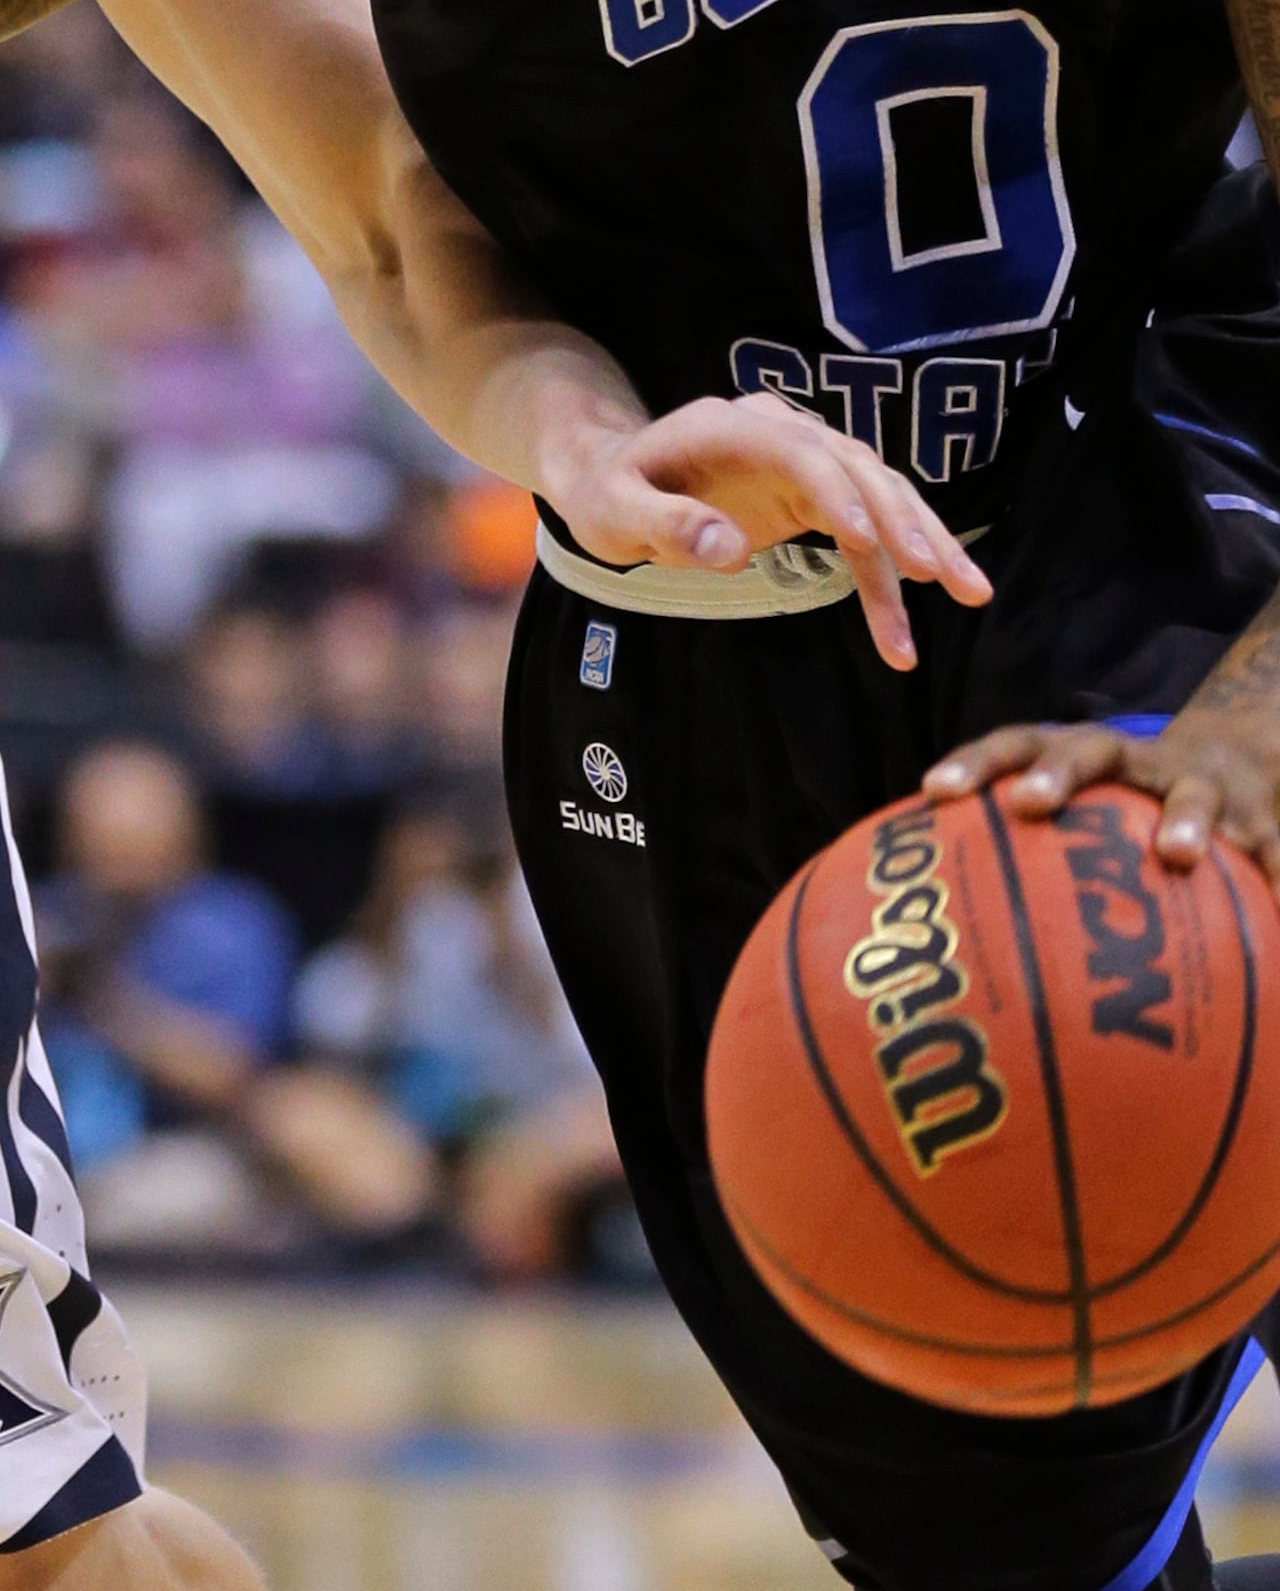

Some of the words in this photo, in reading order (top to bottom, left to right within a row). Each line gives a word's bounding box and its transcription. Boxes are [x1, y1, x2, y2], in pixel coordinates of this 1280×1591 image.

[797, 9, 1077, 353] 0
[729, 329, 1060, 483] STA
[615, 812, 647, 847] BE
[1054, 802, 1175, 1052] NCAA
[844, 804, 1010, 1179] Wilson
